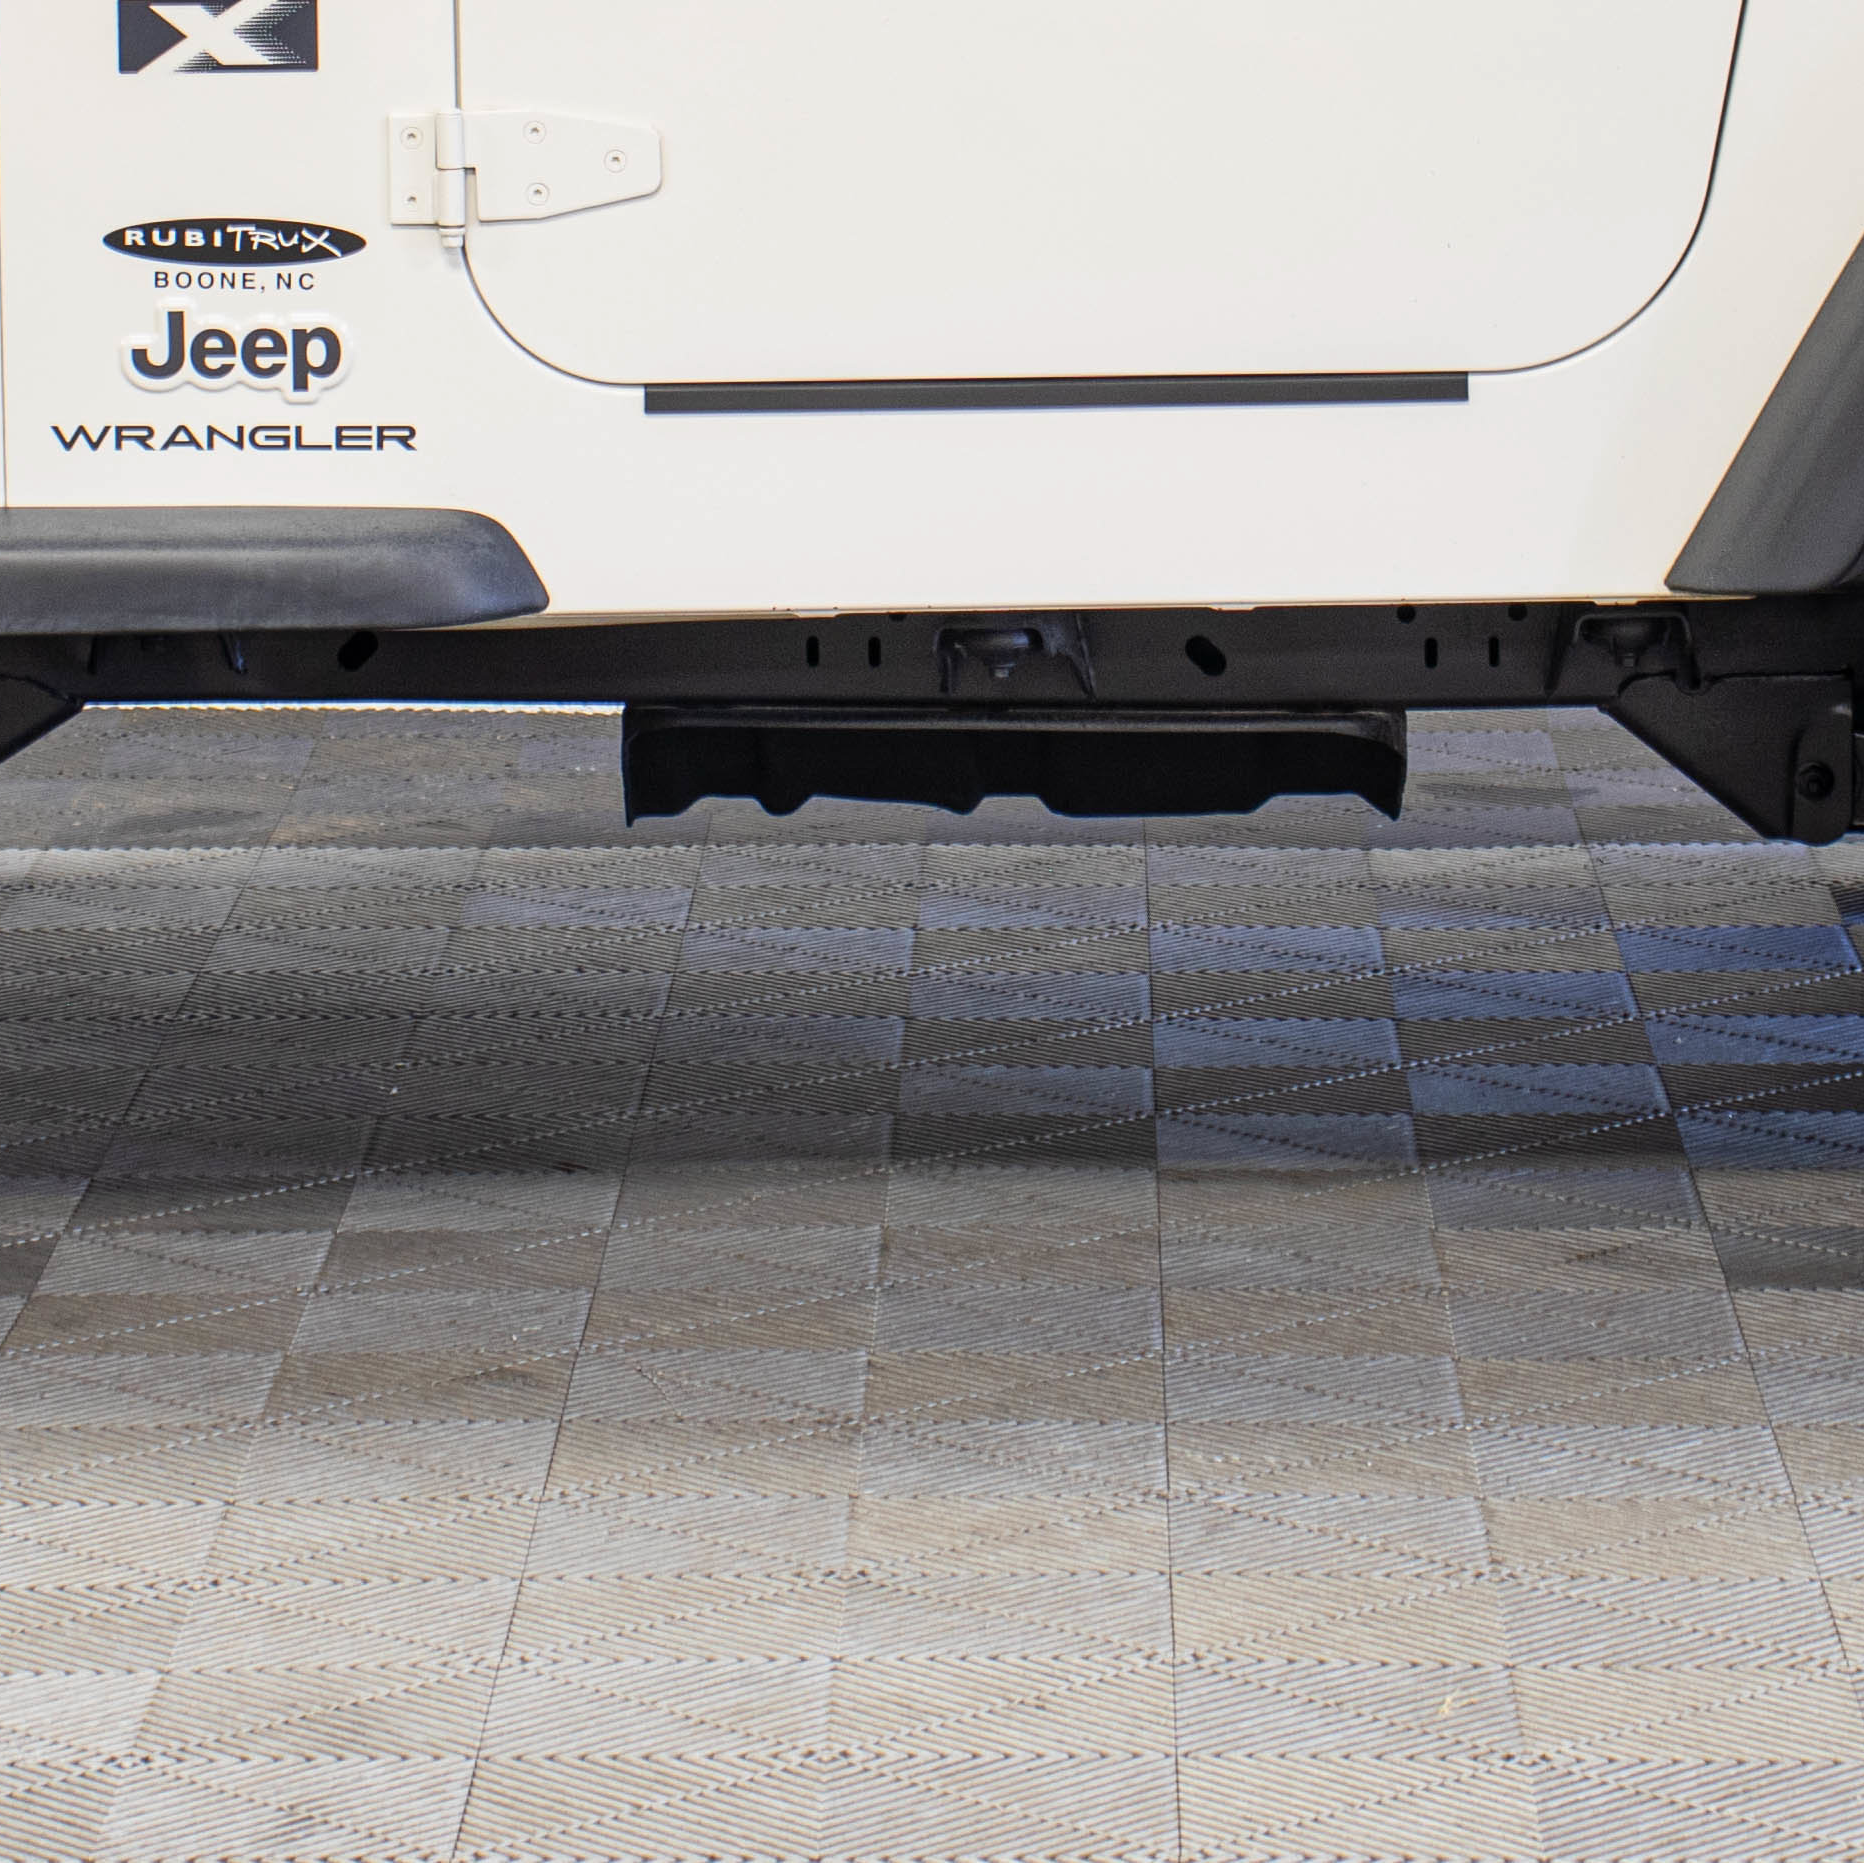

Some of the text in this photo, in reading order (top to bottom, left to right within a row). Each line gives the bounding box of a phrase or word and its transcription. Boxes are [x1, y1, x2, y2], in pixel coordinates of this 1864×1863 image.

[153, 271, 315, 292] BOONE, NC
[132, 310, 341, 392] Jeep
[51, 424, 417, 452] WRANGLER
